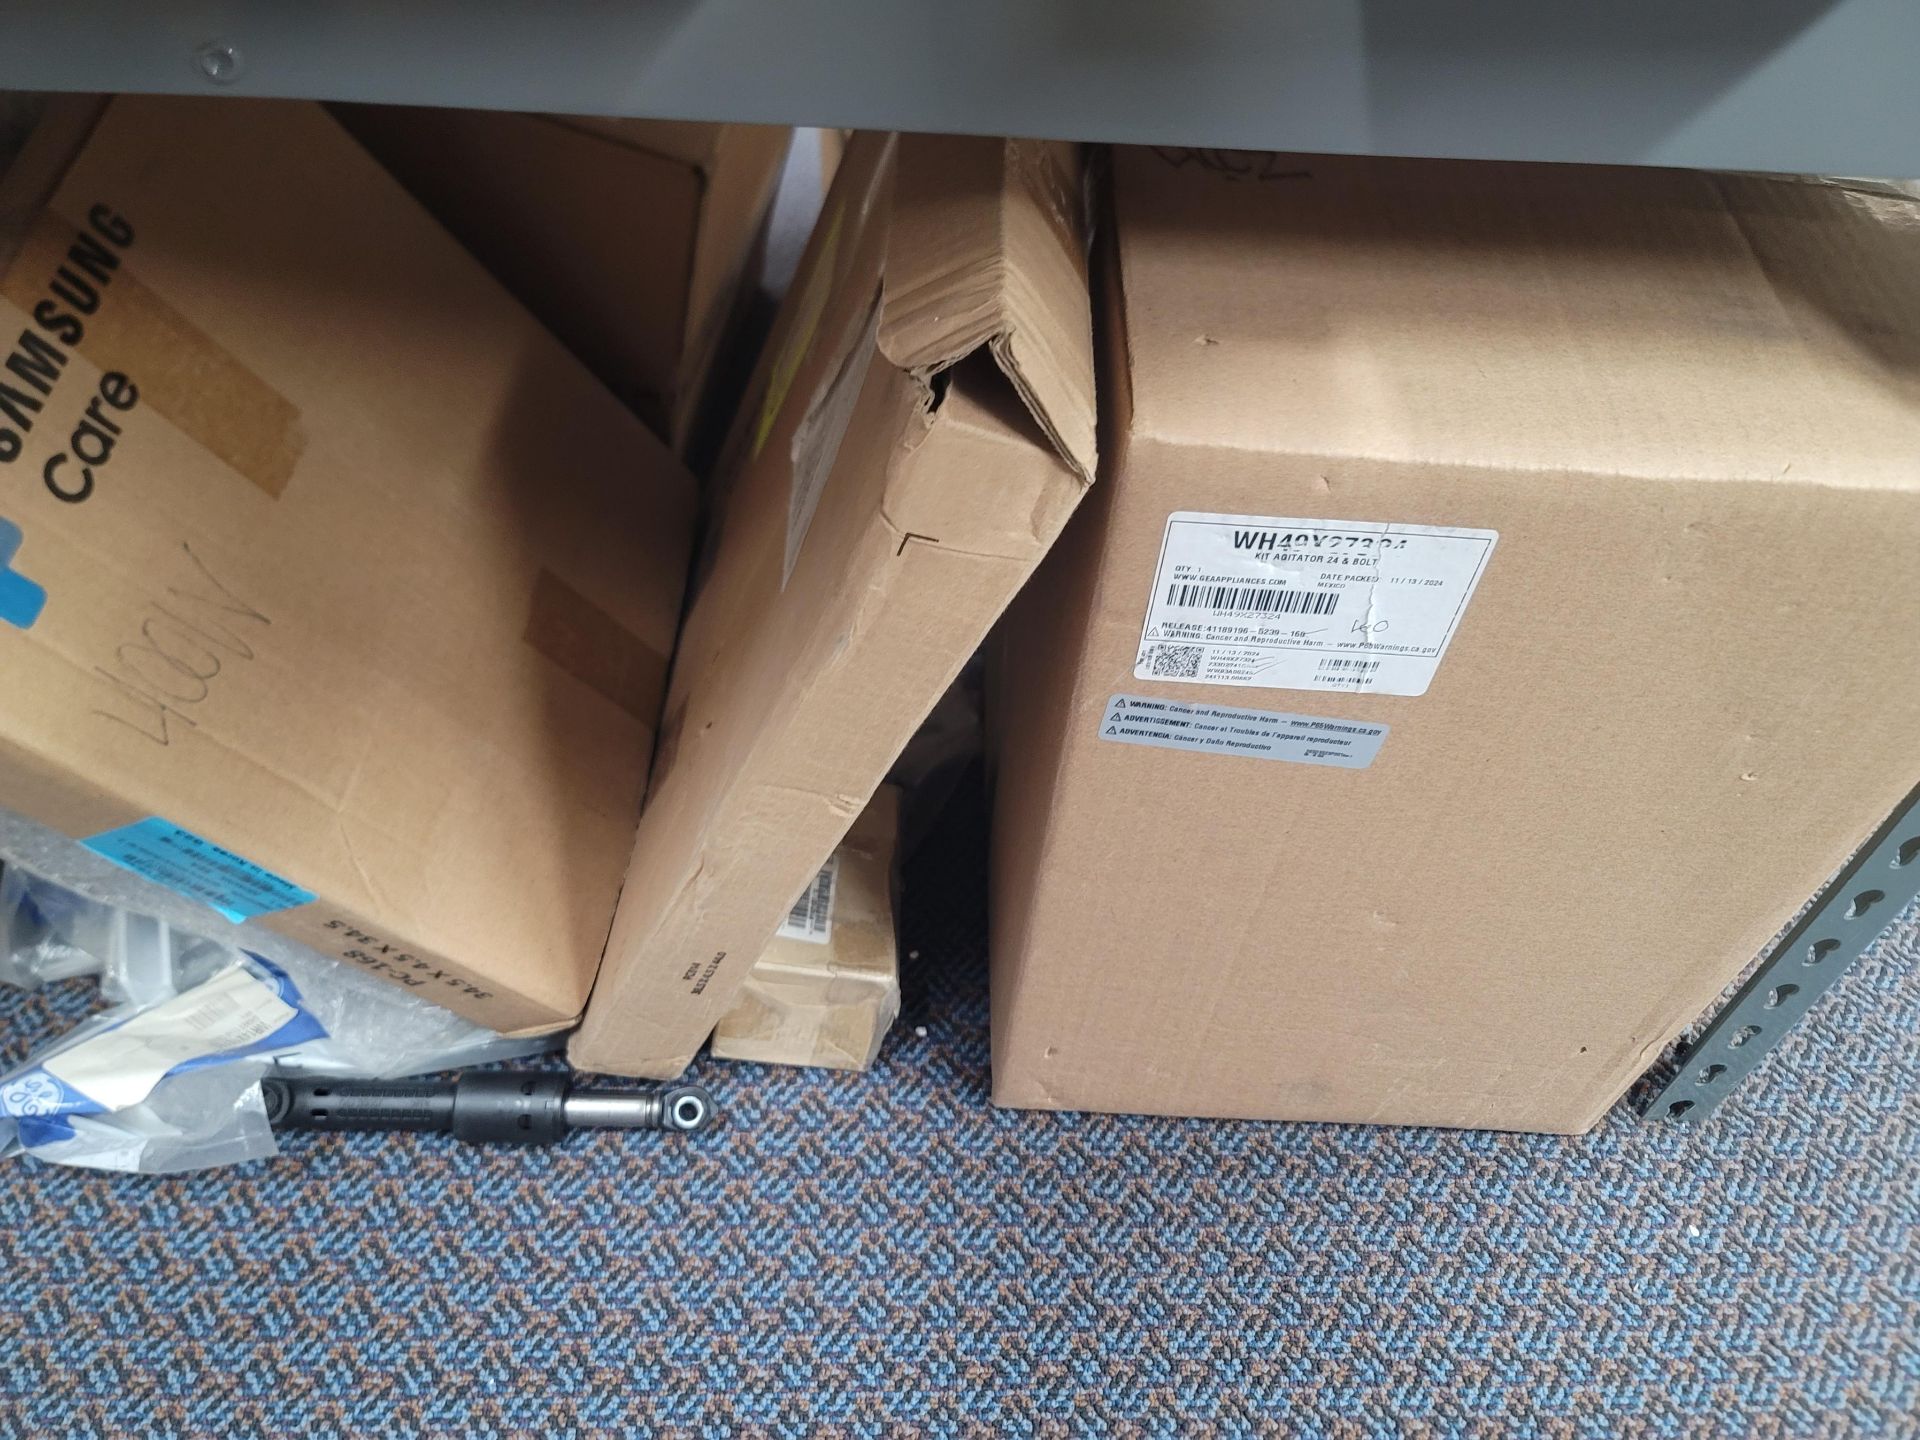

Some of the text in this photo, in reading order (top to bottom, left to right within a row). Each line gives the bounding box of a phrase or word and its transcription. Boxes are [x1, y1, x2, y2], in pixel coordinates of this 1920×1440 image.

[43, 371, 140, 504] Care
[1254, 552, 1270, 561] KIT
[1274, 553, 1324, 564] AGITATOR
[1327, 557, 1339, 565] 24
[1352, 558, 1378, 566] BOLT
[1213, 610, 1281, 620] WH49X27324
[1250, 636, 1301, 646] Reproductive
[1130, 701, 1168, 711] WARNING:
[1169, 706, 1194, 714] Cancer
[1211, 710, 1257, 721] Reproductive
[1259, 716, 1279, 724] Harm
[1120, 728, 1172, 740] ADVERTENCIA:
[1226, 740, 1272, 751] Reproductivo
[1194, 723, 1219, 732] Cancer
[1230, 727, 1259, 736] Troubles
[1261, 730, 1271, 738] de
[1306, 736, 1352, 747] reproducteur
